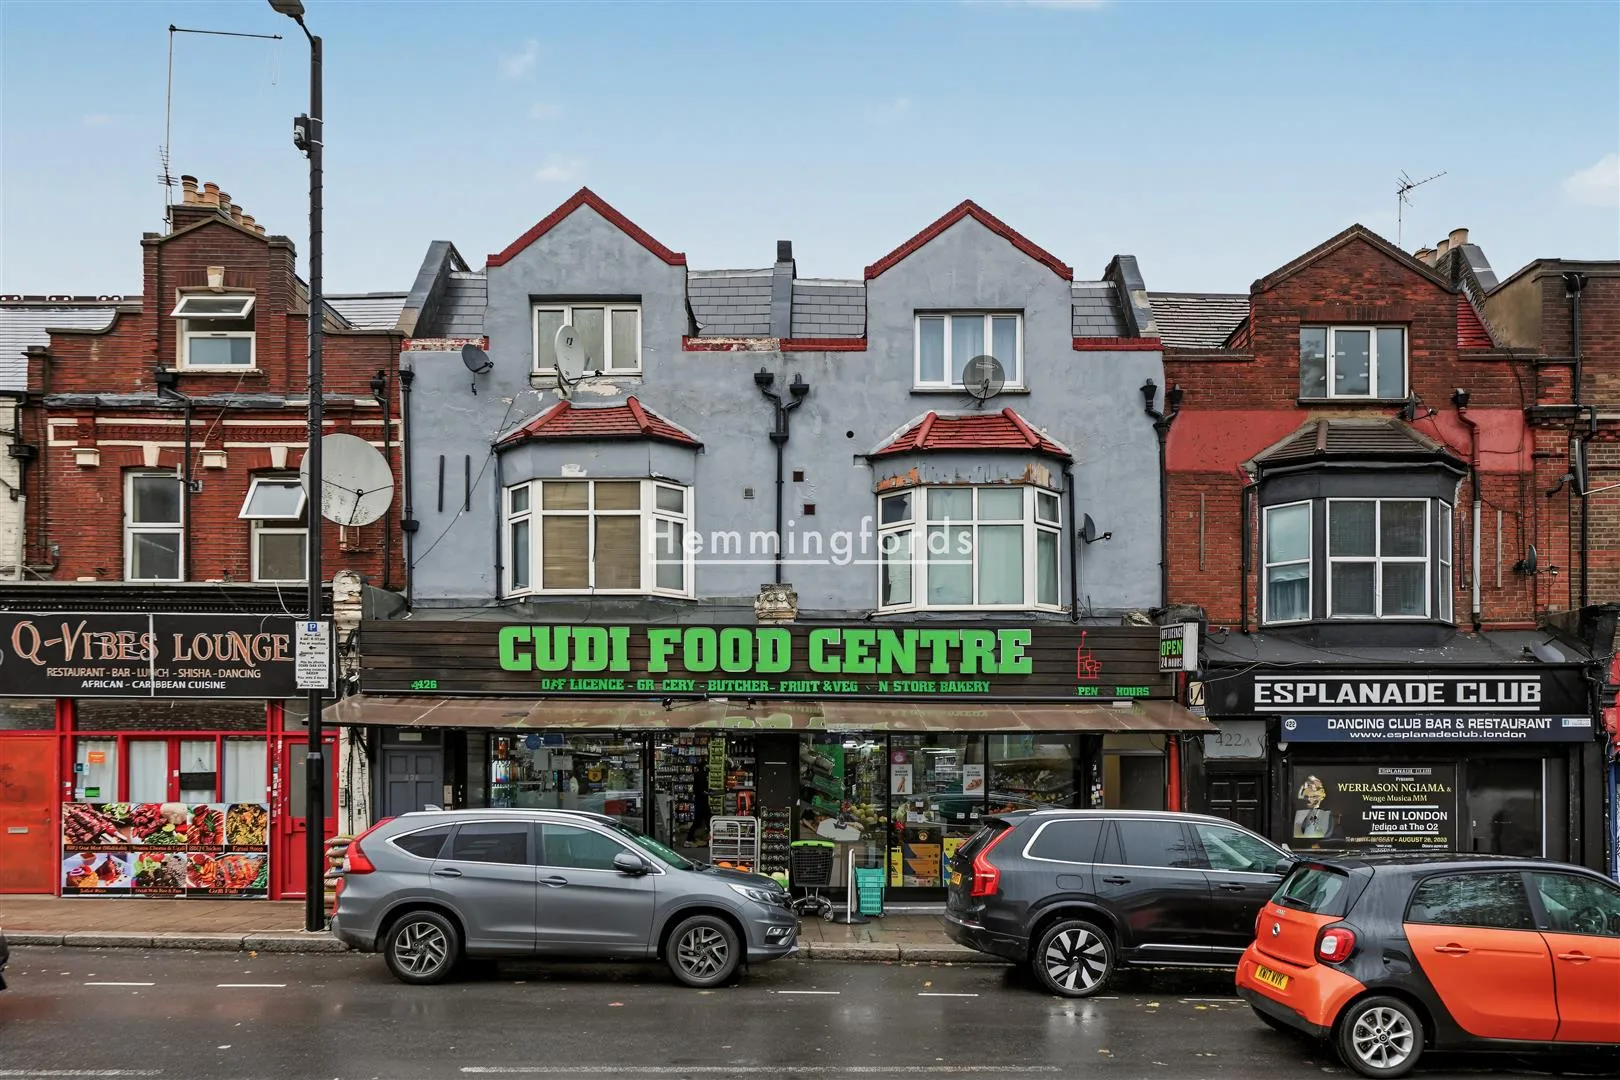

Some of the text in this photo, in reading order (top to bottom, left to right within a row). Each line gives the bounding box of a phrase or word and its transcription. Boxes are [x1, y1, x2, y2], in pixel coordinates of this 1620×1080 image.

[172, 631, 294, 667] LOUNGE
[499, 626, 1033, 674] CUDI FOOD CENTRE
[1161, 639, 1183, 656] OPEN
[1160, 656, 1183, 668] 24 HOURS
[47, 668, 105, 678] RESTAURANT
[112, 668, 130, 678] BAR
[178, 668, 211, 678] SHISHA
[218, 669, 261, 679] DANCING
[81, 680, 123, 688] AFRICAN
[188, 681, 226, 689] CUISINE
[569, 679, 625, 691] LICENCE
[780, 681, 820, 692] FRUIT
[893, 681, 936, 692] STORE
[940, 681, 990, 692] BAKERY
[1115, 687, 1150, 696] HOURS
[1254, 682, 1542, 703] ESPLANADE CLUB
[1327, 718, 1553, 729] DANCING CLUB BAR & RESTAURANT
[1349, 731, 1527, 739] www.esplanadeclub.london
[1337, 783, 1399, 792] WERRASON
[1401, 783, 1445, 792] NGIAMA
[1362, 794, 1386, 803] Wenge
[1387, 794, 1412, 802] Musica
[1362, 811, 1448, 820] LIVE IN LONDON
[1399, 823, 1408, 831] at
[1409, 822, 1424, 831] The
